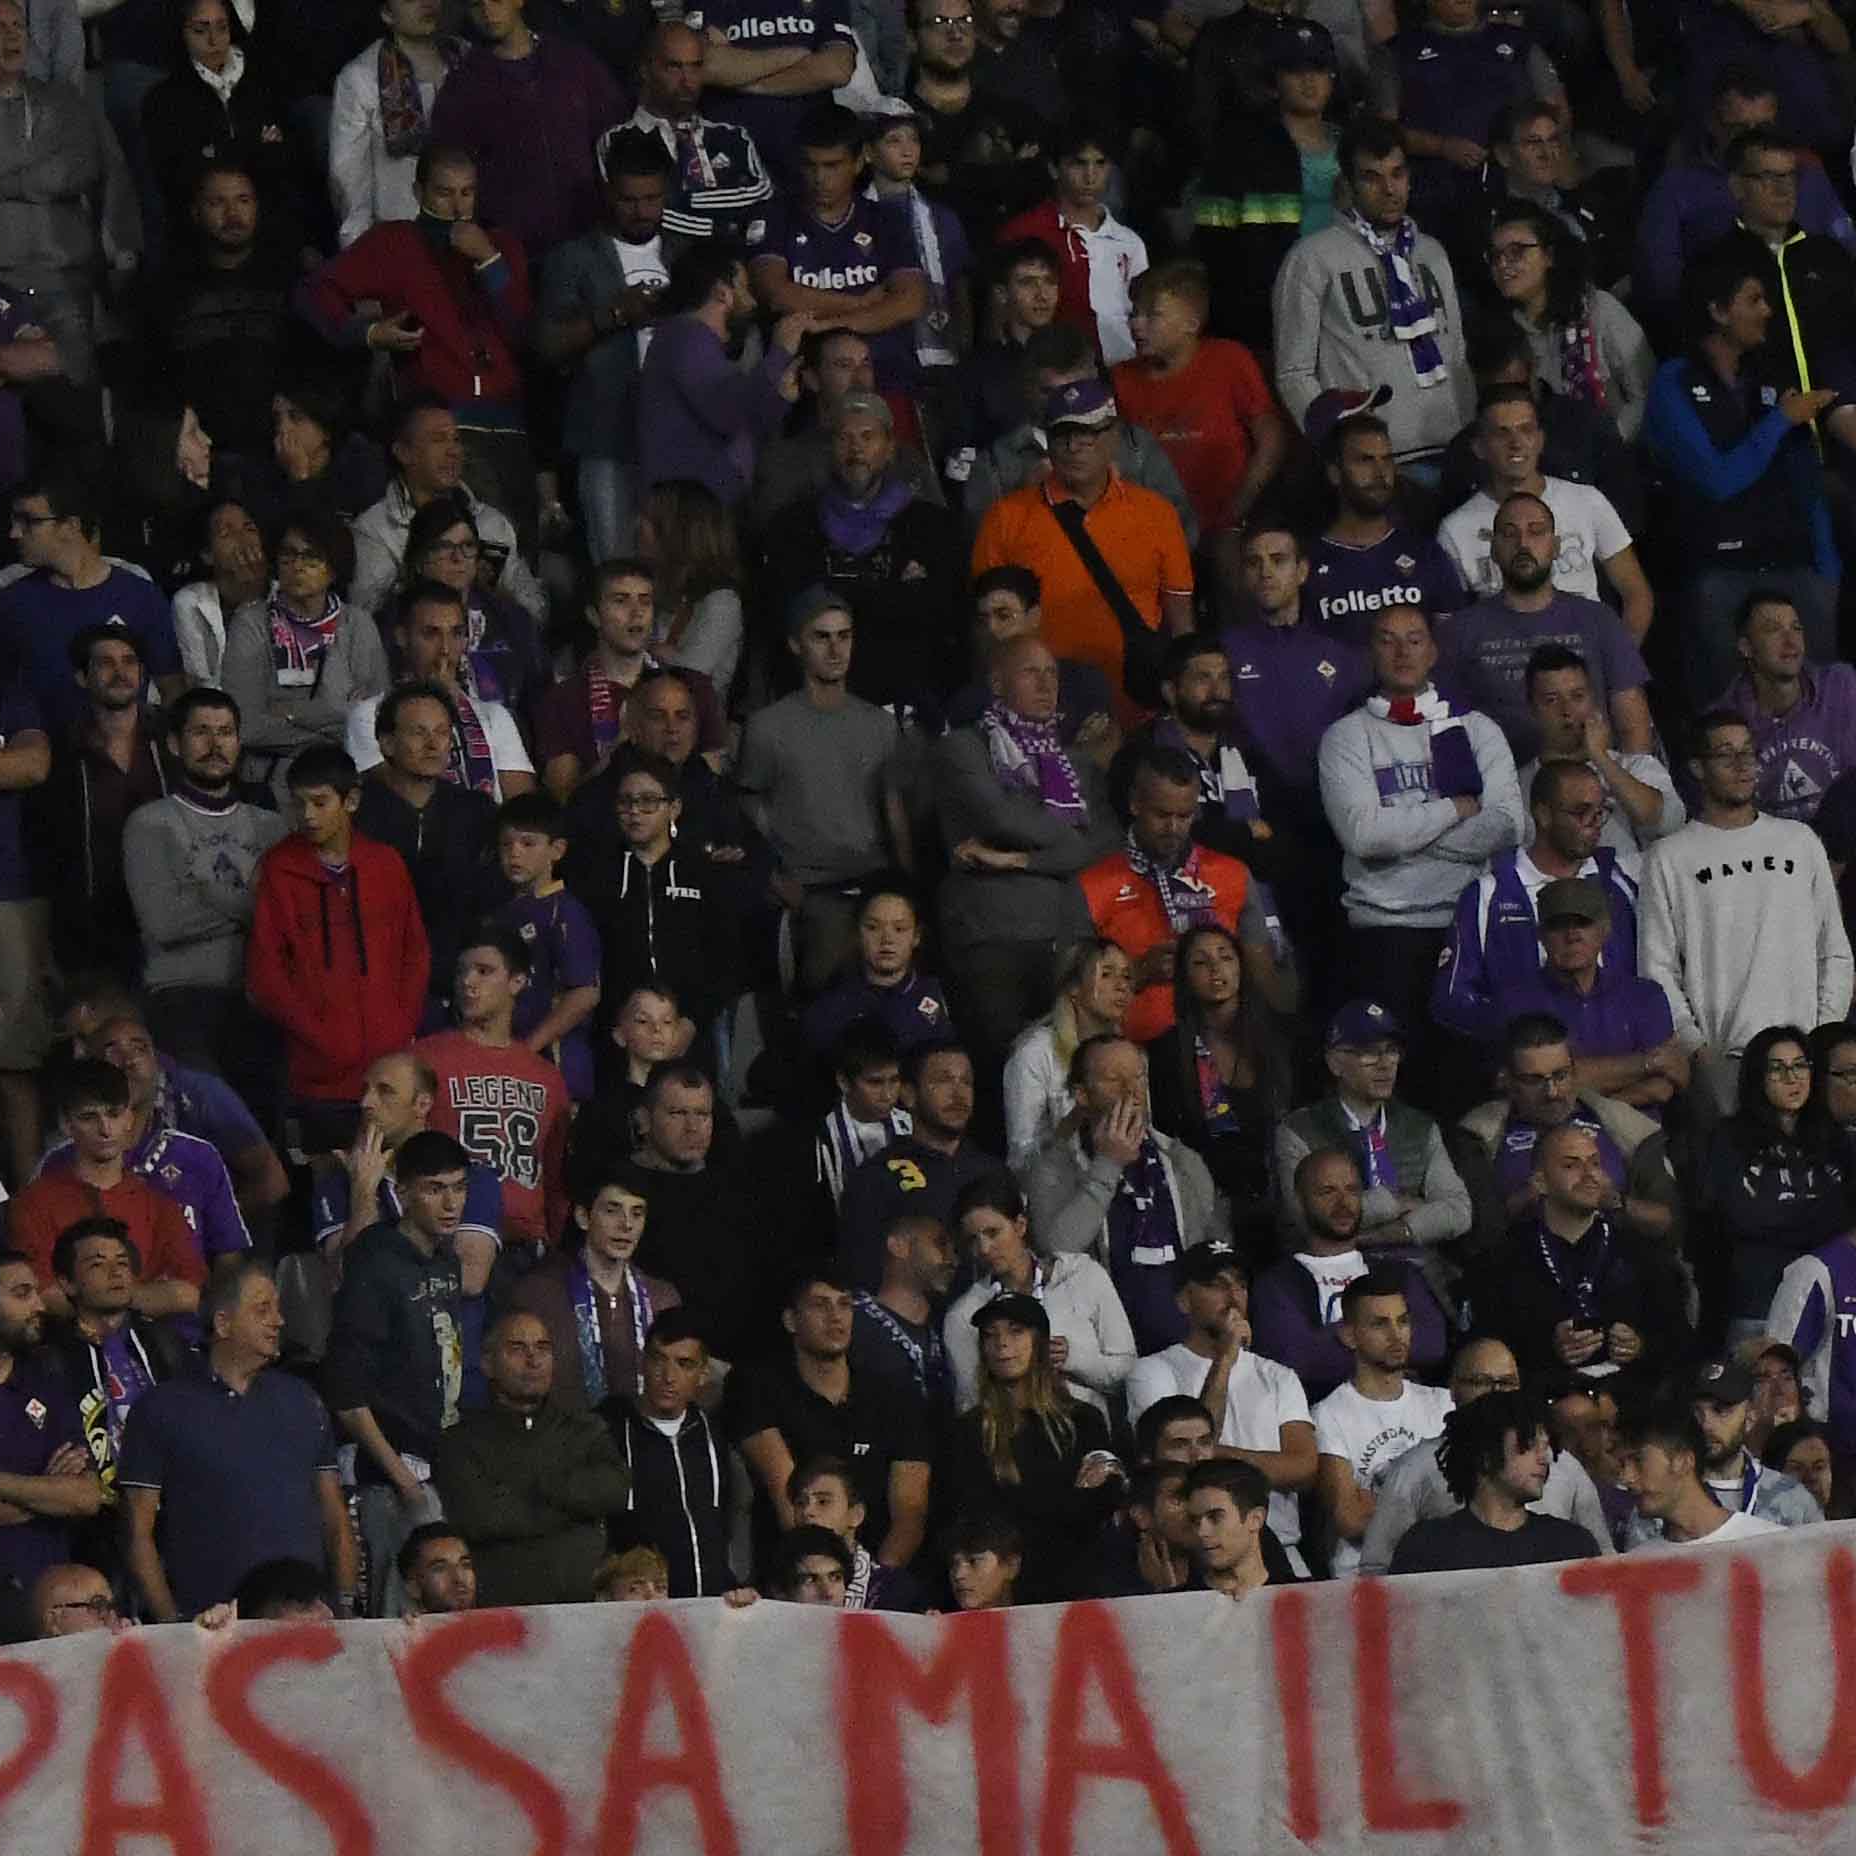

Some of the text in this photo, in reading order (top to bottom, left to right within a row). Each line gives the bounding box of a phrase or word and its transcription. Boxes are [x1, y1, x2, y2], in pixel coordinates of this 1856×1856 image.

[727, 17, 815, 42] olletto
[792, 264, 879, 290] folletto
[1319, 584, 1423, 620] folletto
[448, 1076, 547, 1114] LEGEND
[1271, 1578, 1465, 1844] IL
